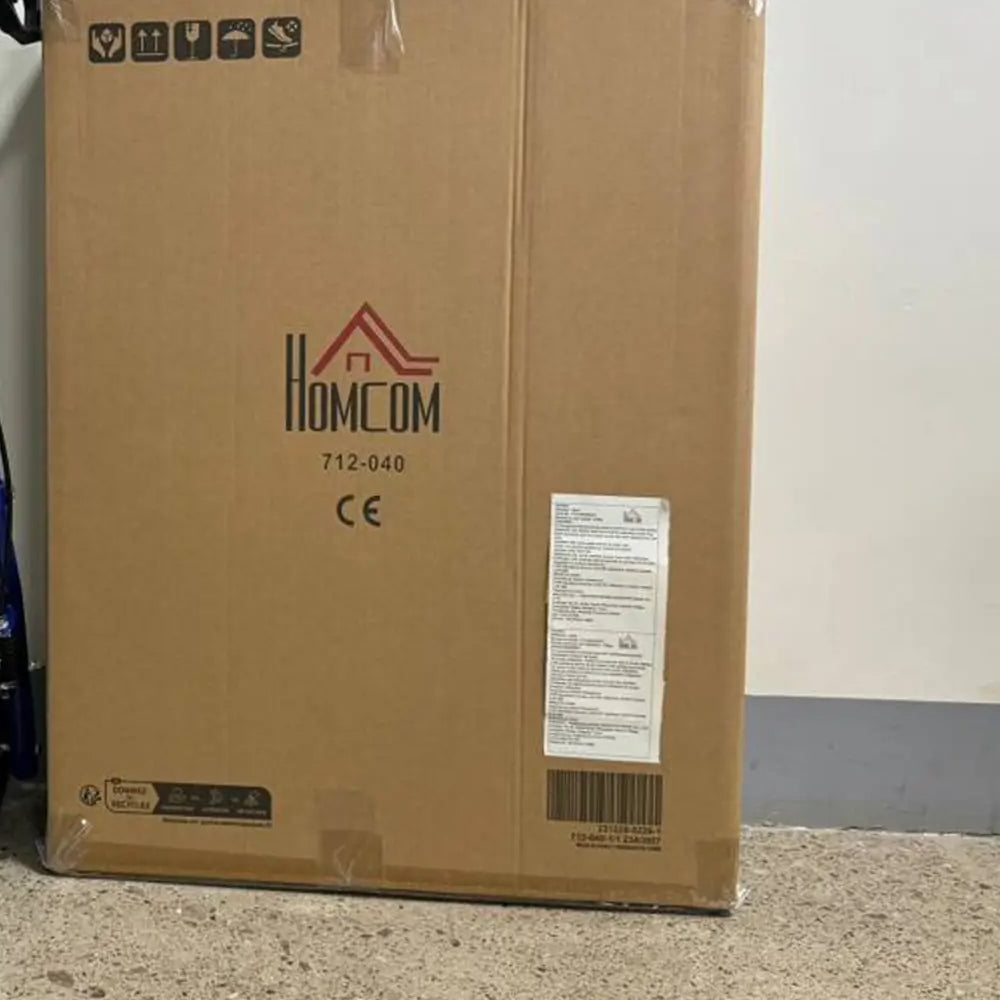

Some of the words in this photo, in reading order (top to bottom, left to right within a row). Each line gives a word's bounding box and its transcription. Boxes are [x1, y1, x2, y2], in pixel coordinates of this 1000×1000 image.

[286, 334, 440, 433] HOMCOM
[322, 453, 405, 473] 712-040
[336, 495, 381, 528] CE
